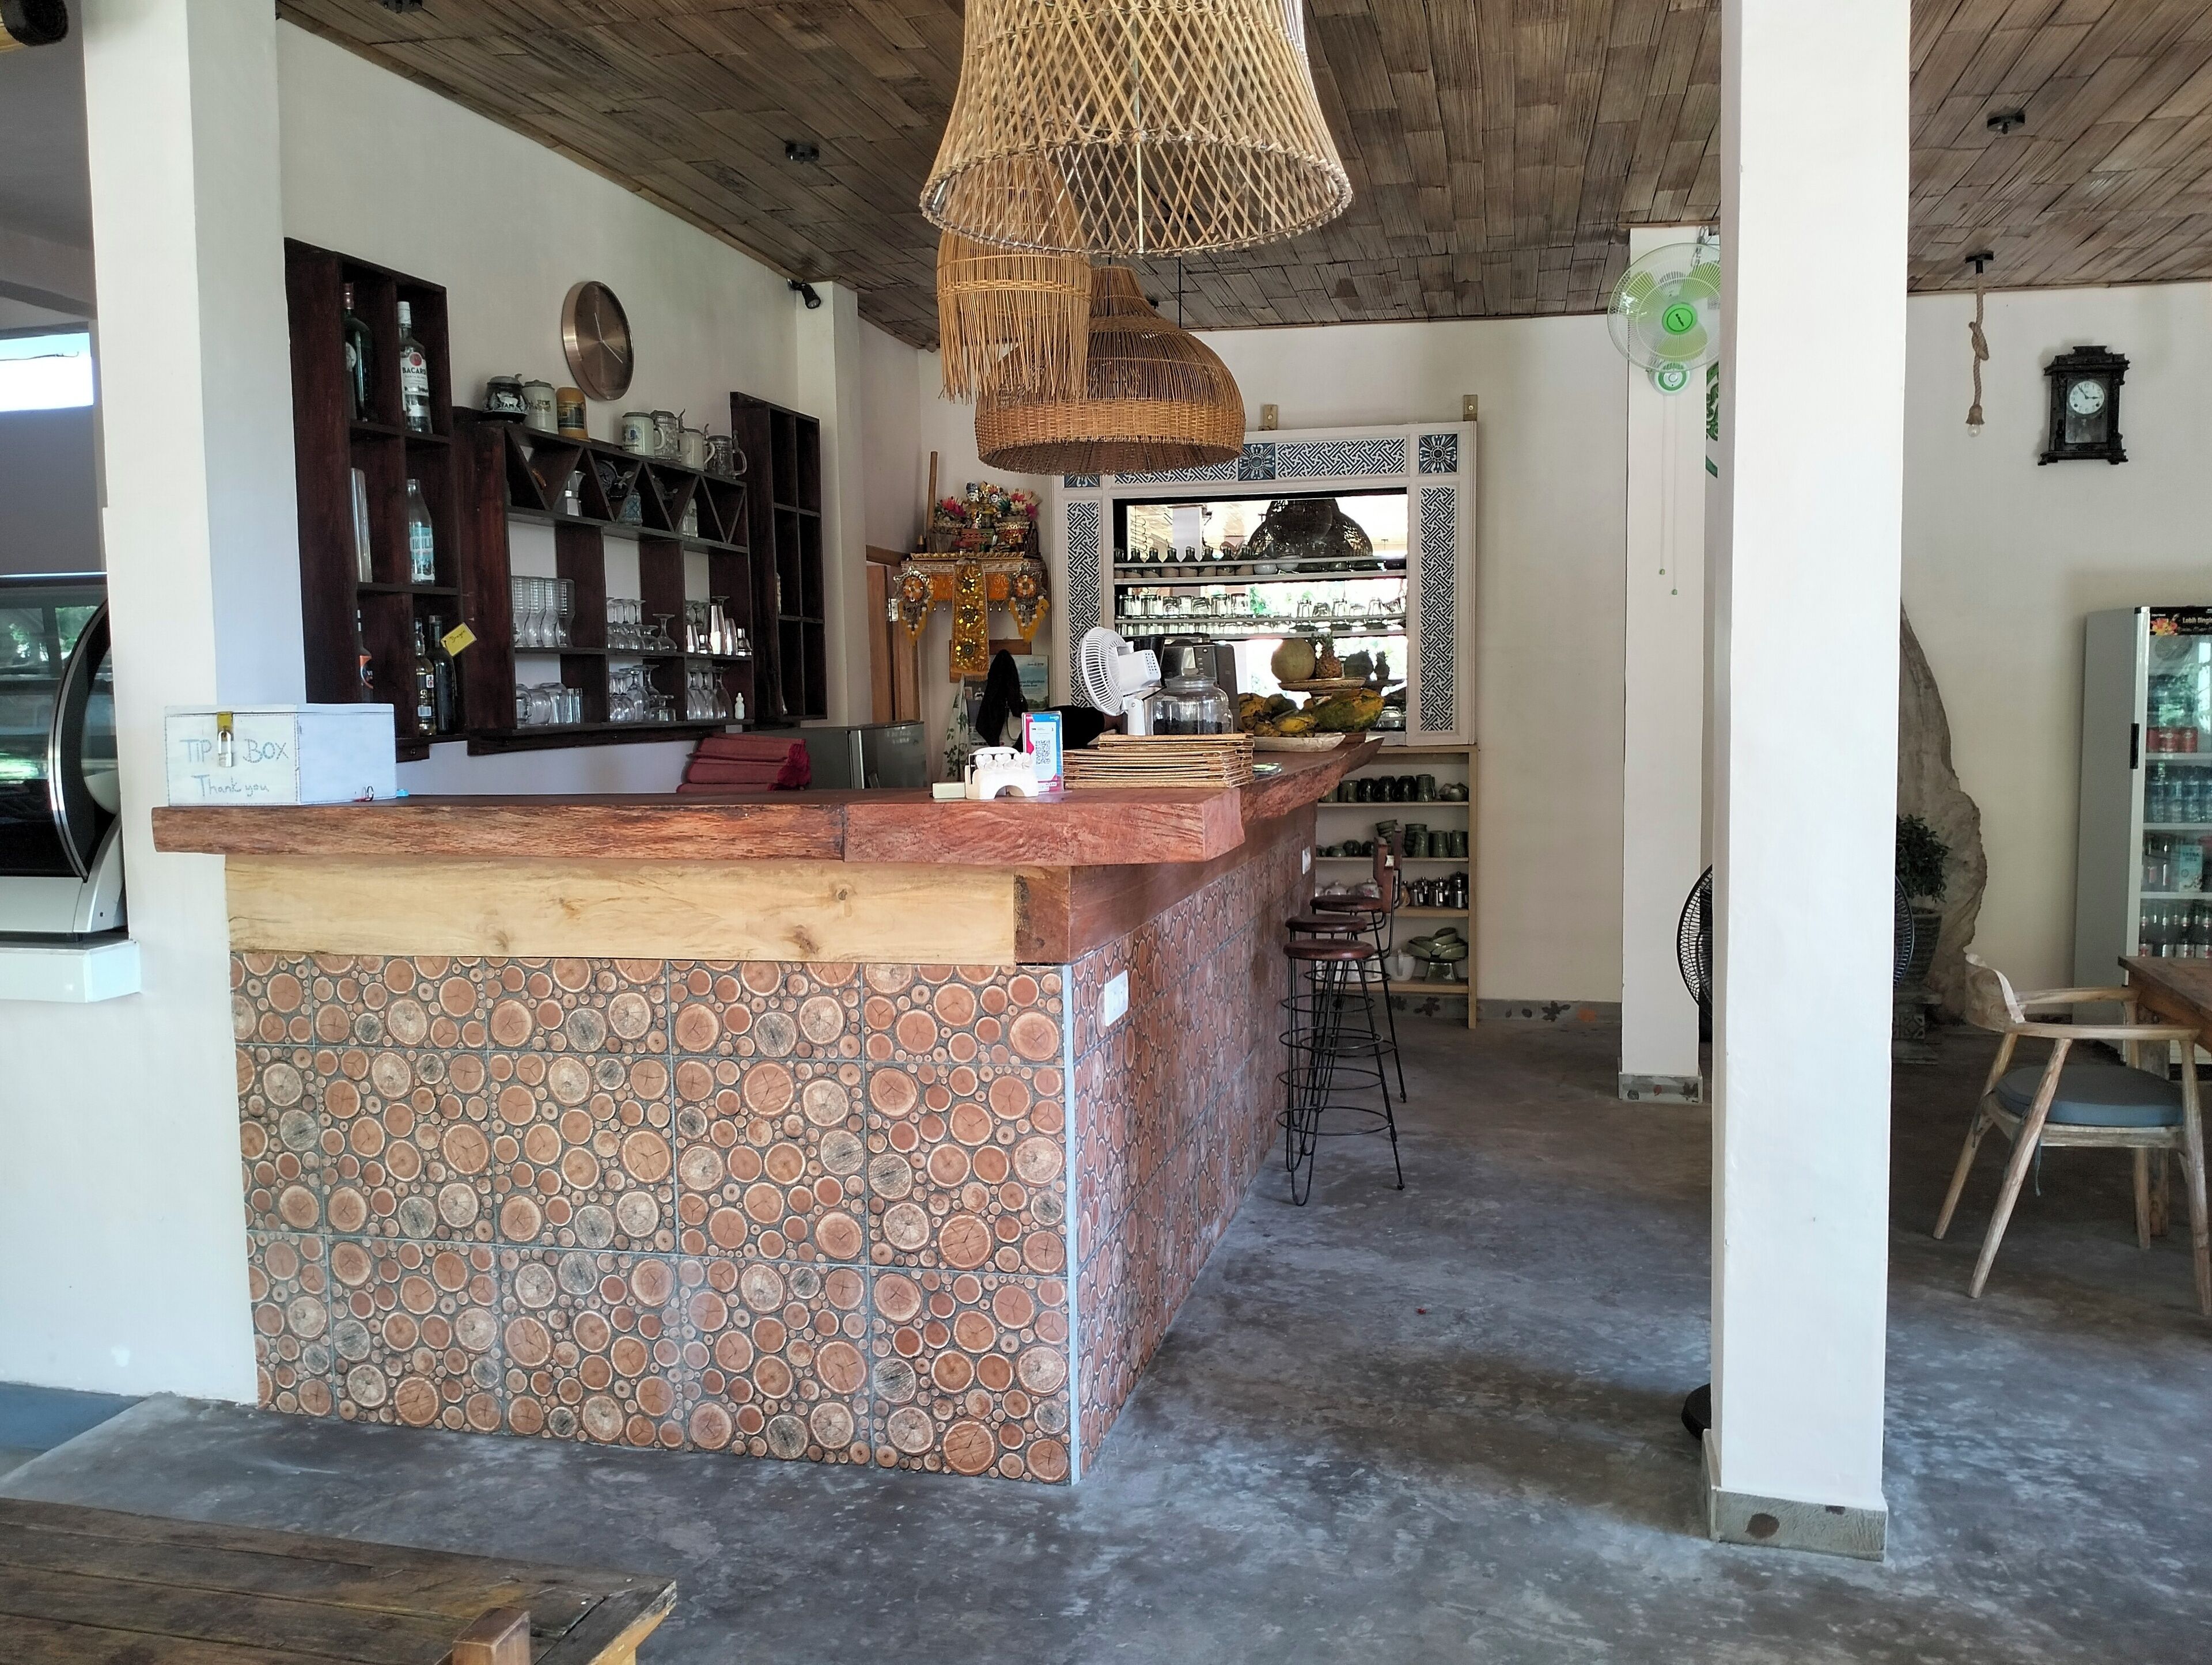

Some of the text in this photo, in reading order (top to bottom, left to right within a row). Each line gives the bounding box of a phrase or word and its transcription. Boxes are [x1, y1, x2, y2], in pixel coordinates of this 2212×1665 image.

[243, 738, 289, 763] BOX
[191, 774, 270, 797] Thank you
